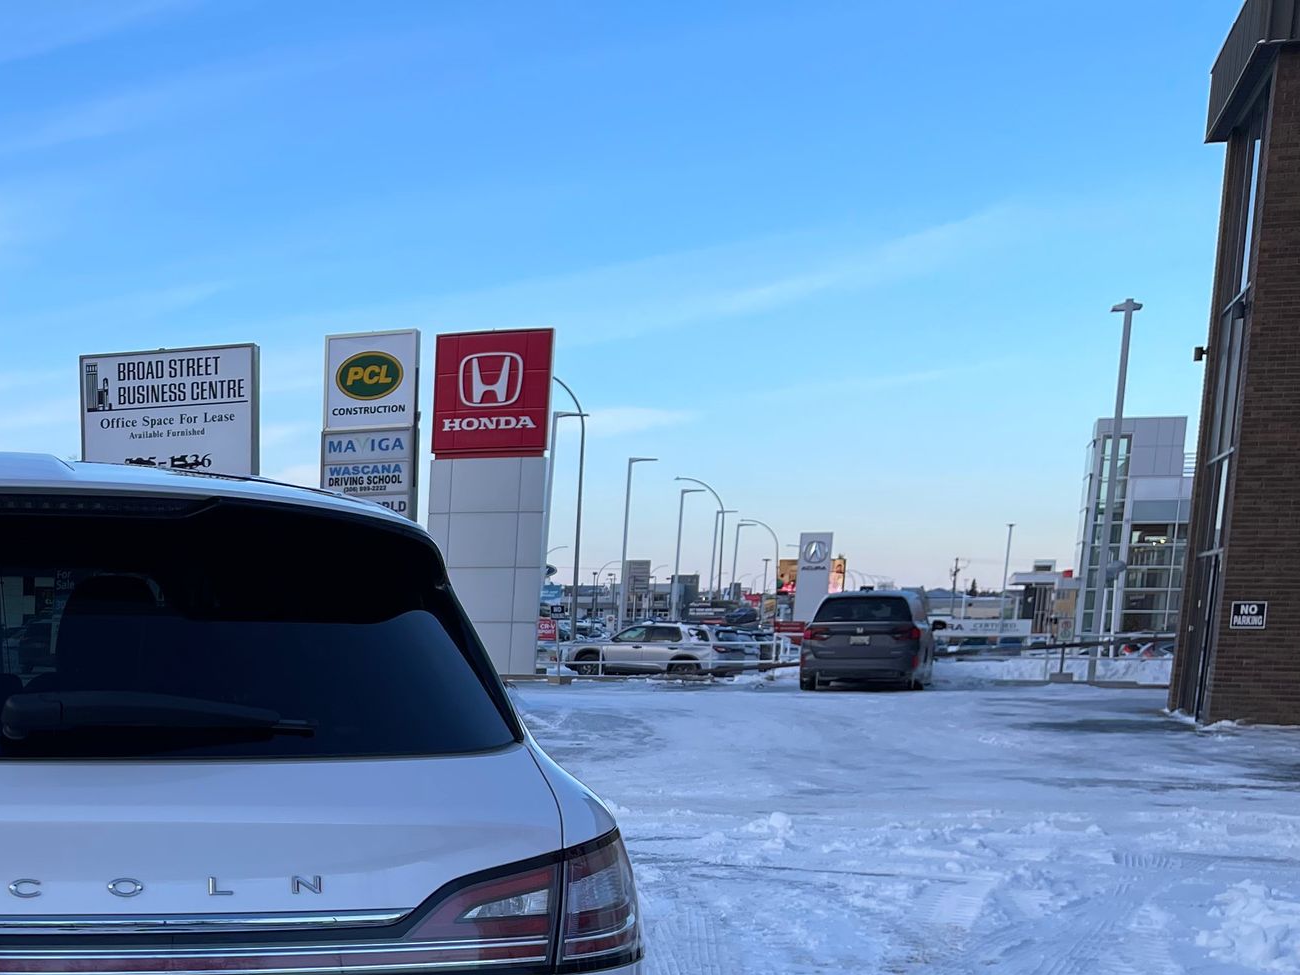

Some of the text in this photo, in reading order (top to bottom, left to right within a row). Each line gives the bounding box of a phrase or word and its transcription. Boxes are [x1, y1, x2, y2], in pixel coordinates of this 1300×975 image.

[117, 356, 220, 381] BROAD STREET
[346, 364, 392, 386] PCL
[118, 379, 245, 405] BUSINESS CENTRE
[332, 404, 406, 416] CONSTRUCTION
[100, 412, 235, 429] Office Space For Lease
[442, 416, 536, 431] HONDA
[129, 428, 205, 439] Available Furnished
[329, 464, 402, 476] WASCANA
[328, 474, 402, 487] DRIVING SCHOOL
[1240, 604, 1258, 615] NO
[1233, 615, 1263, 625] PARKING
